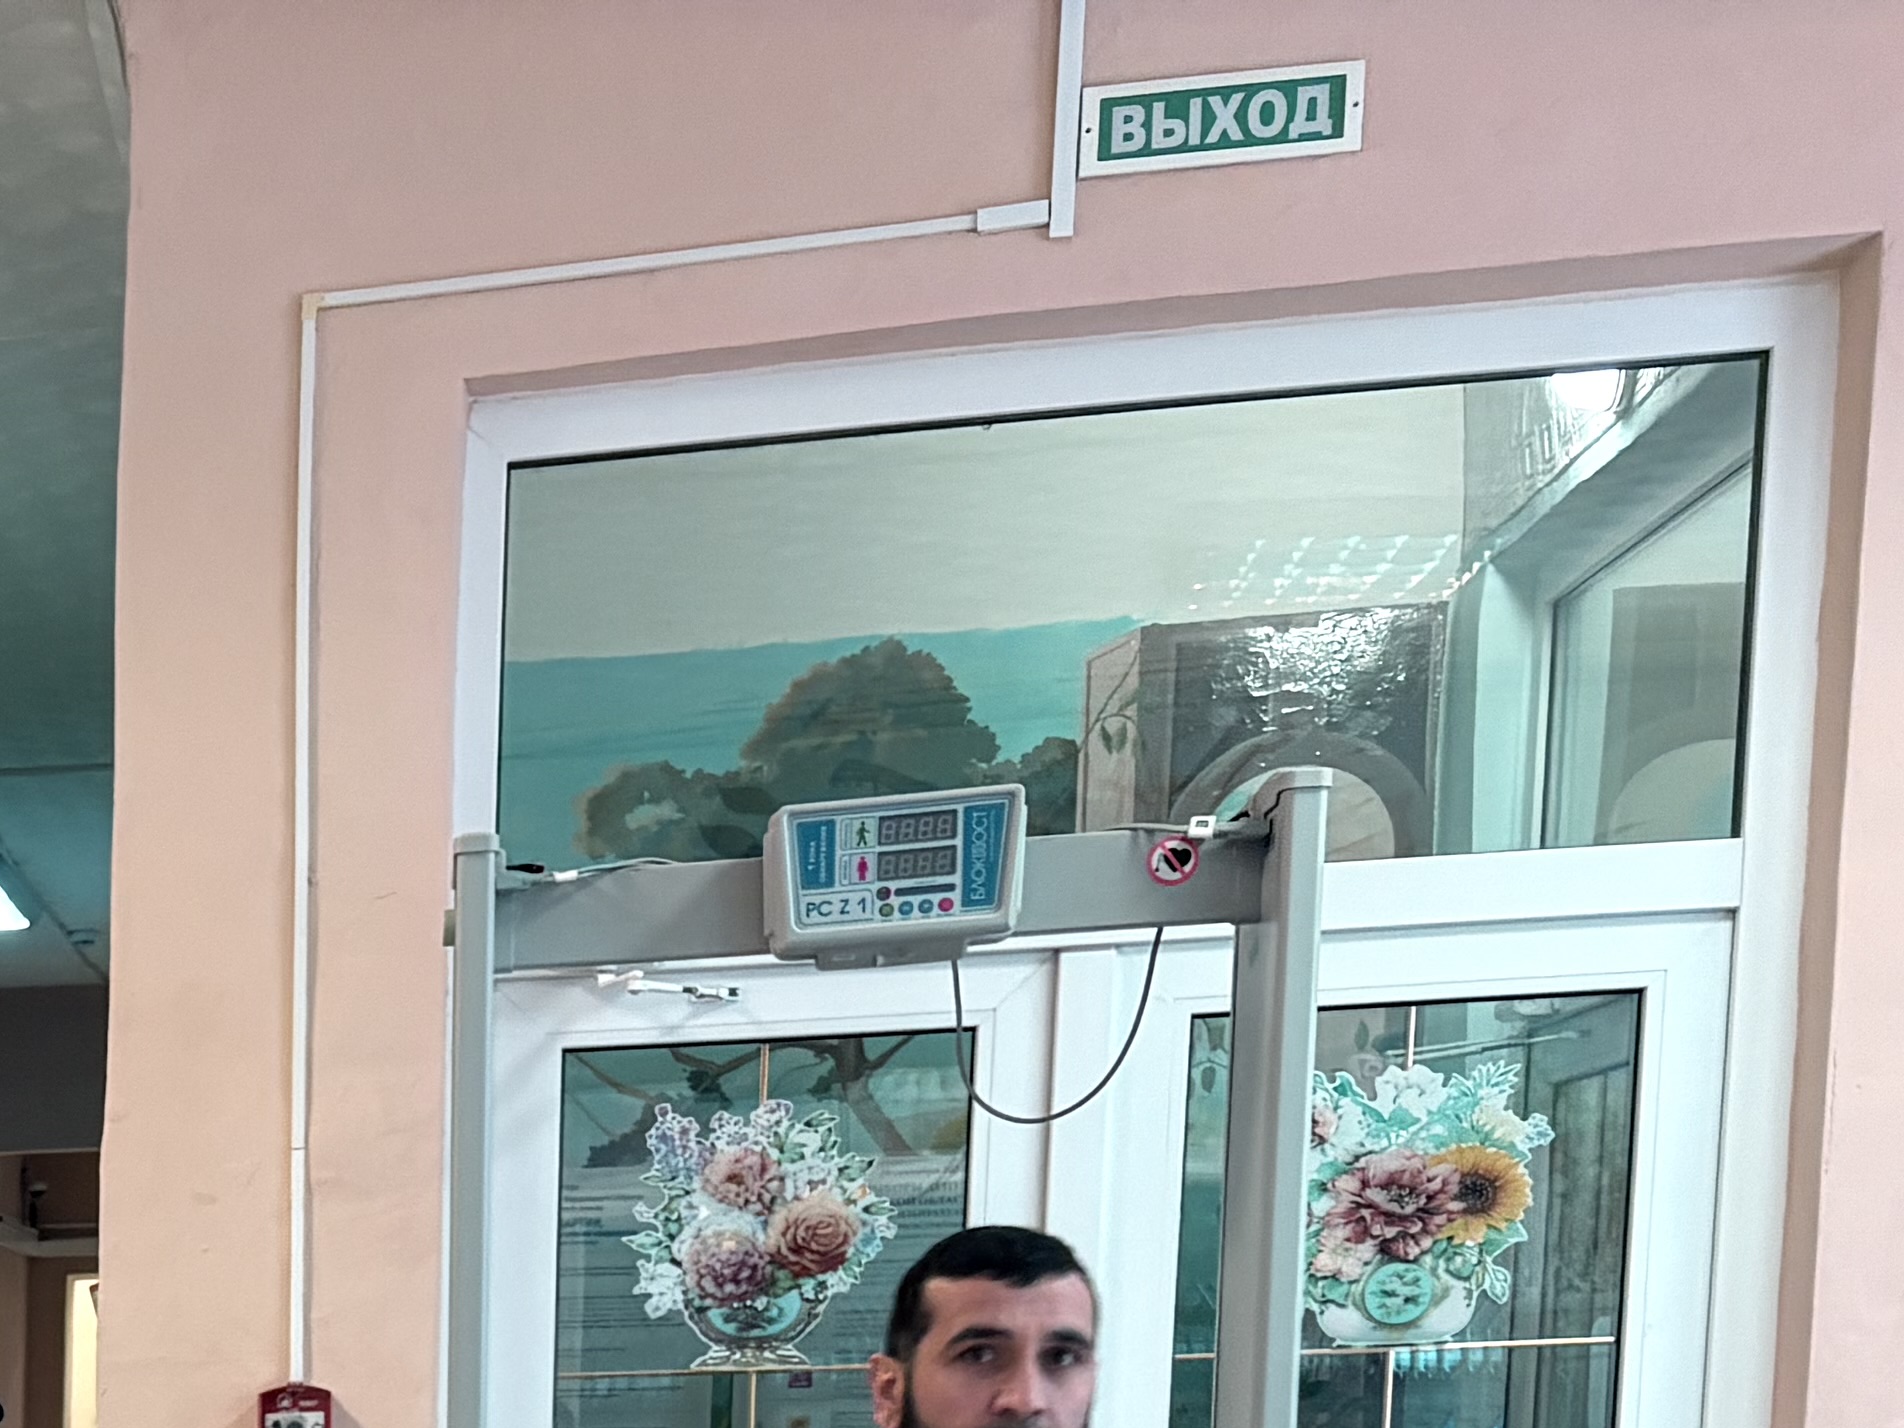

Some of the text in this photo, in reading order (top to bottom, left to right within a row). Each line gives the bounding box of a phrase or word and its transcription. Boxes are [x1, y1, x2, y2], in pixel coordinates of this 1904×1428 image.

[1111, 83, 1332, 156] ВЫХОД
[839, 898, 851, 915] Z
[857, 897, 867, 914] 1
